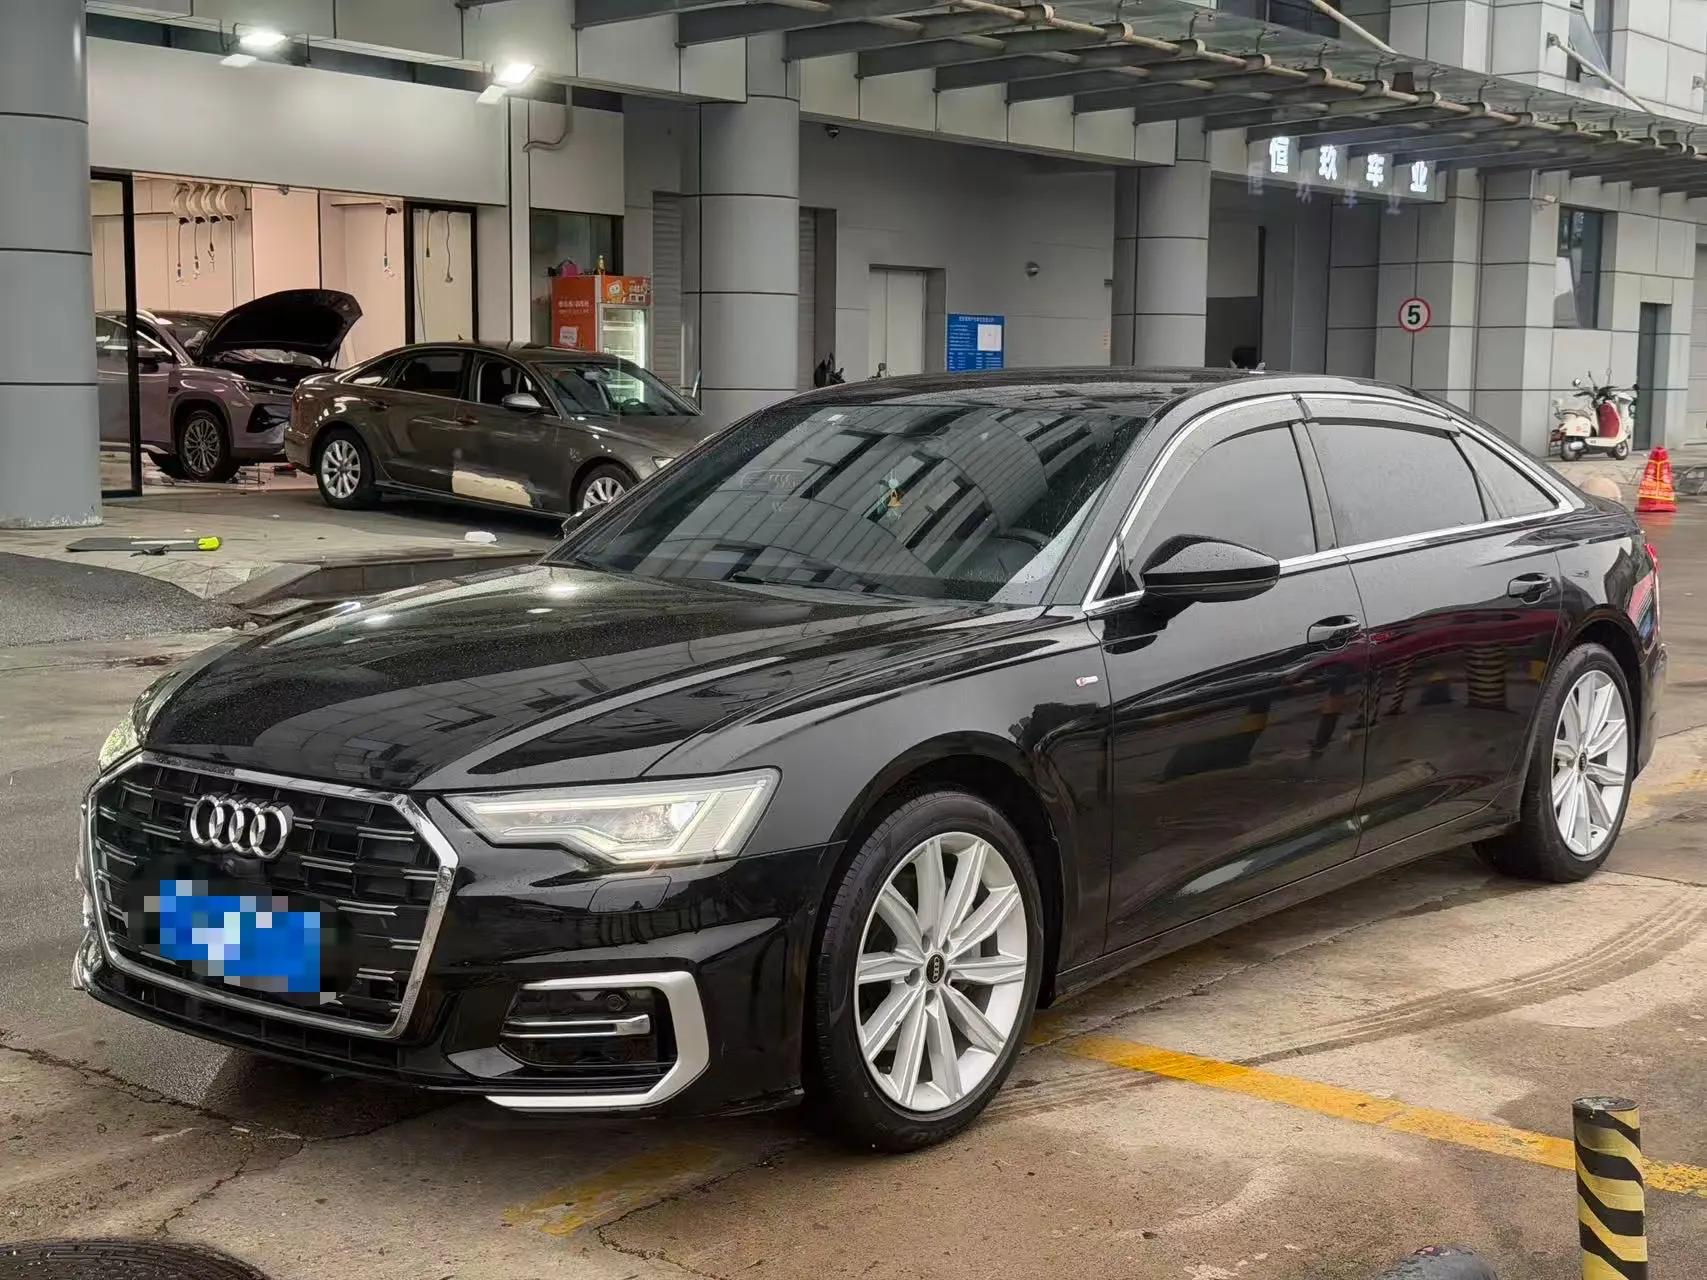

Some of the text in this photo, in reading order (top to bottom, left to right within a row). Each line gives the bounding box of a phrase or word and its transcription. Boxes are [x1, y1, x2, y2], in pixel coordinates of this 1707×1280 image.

[1269, 136, 1428, 193] 恒玖车业
[1407, 304, 1421, 325] 5
